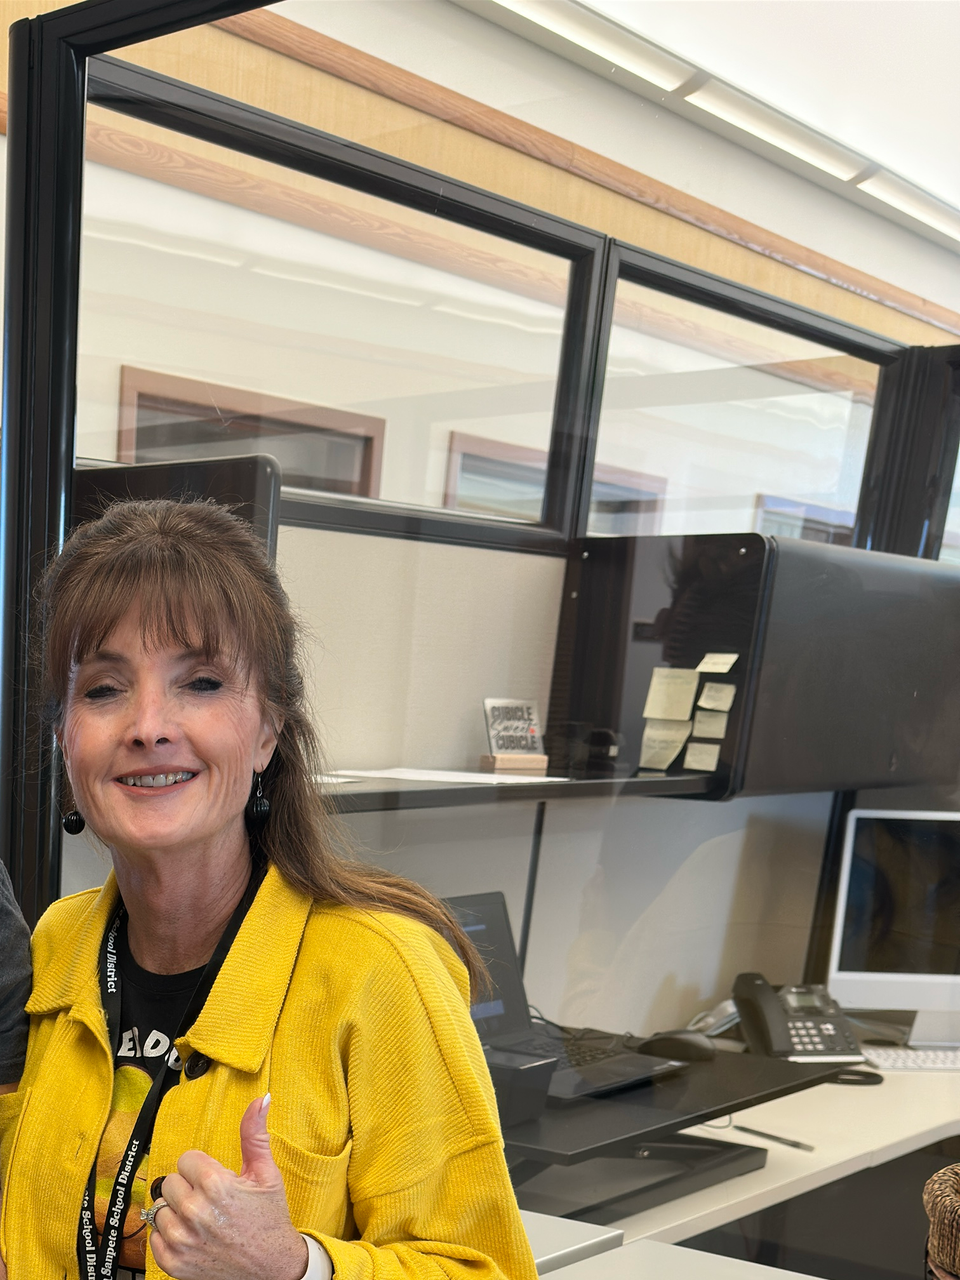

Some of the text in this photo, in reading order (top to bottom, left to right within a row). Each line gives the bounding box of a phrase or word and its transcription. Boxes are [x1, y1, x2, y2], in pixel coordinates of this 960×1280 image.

[491, 706, 534, 721] CUBICLE
[496, 735, 538, 750] CUBICLE
[106, 953, 118, 993] District
[101, 1229, 118, 1276] Sanpete
[110, 1186, 125, 1228] School
[118, 1139, 140, 1184] District
[82, 1210, 95, 1251] School
